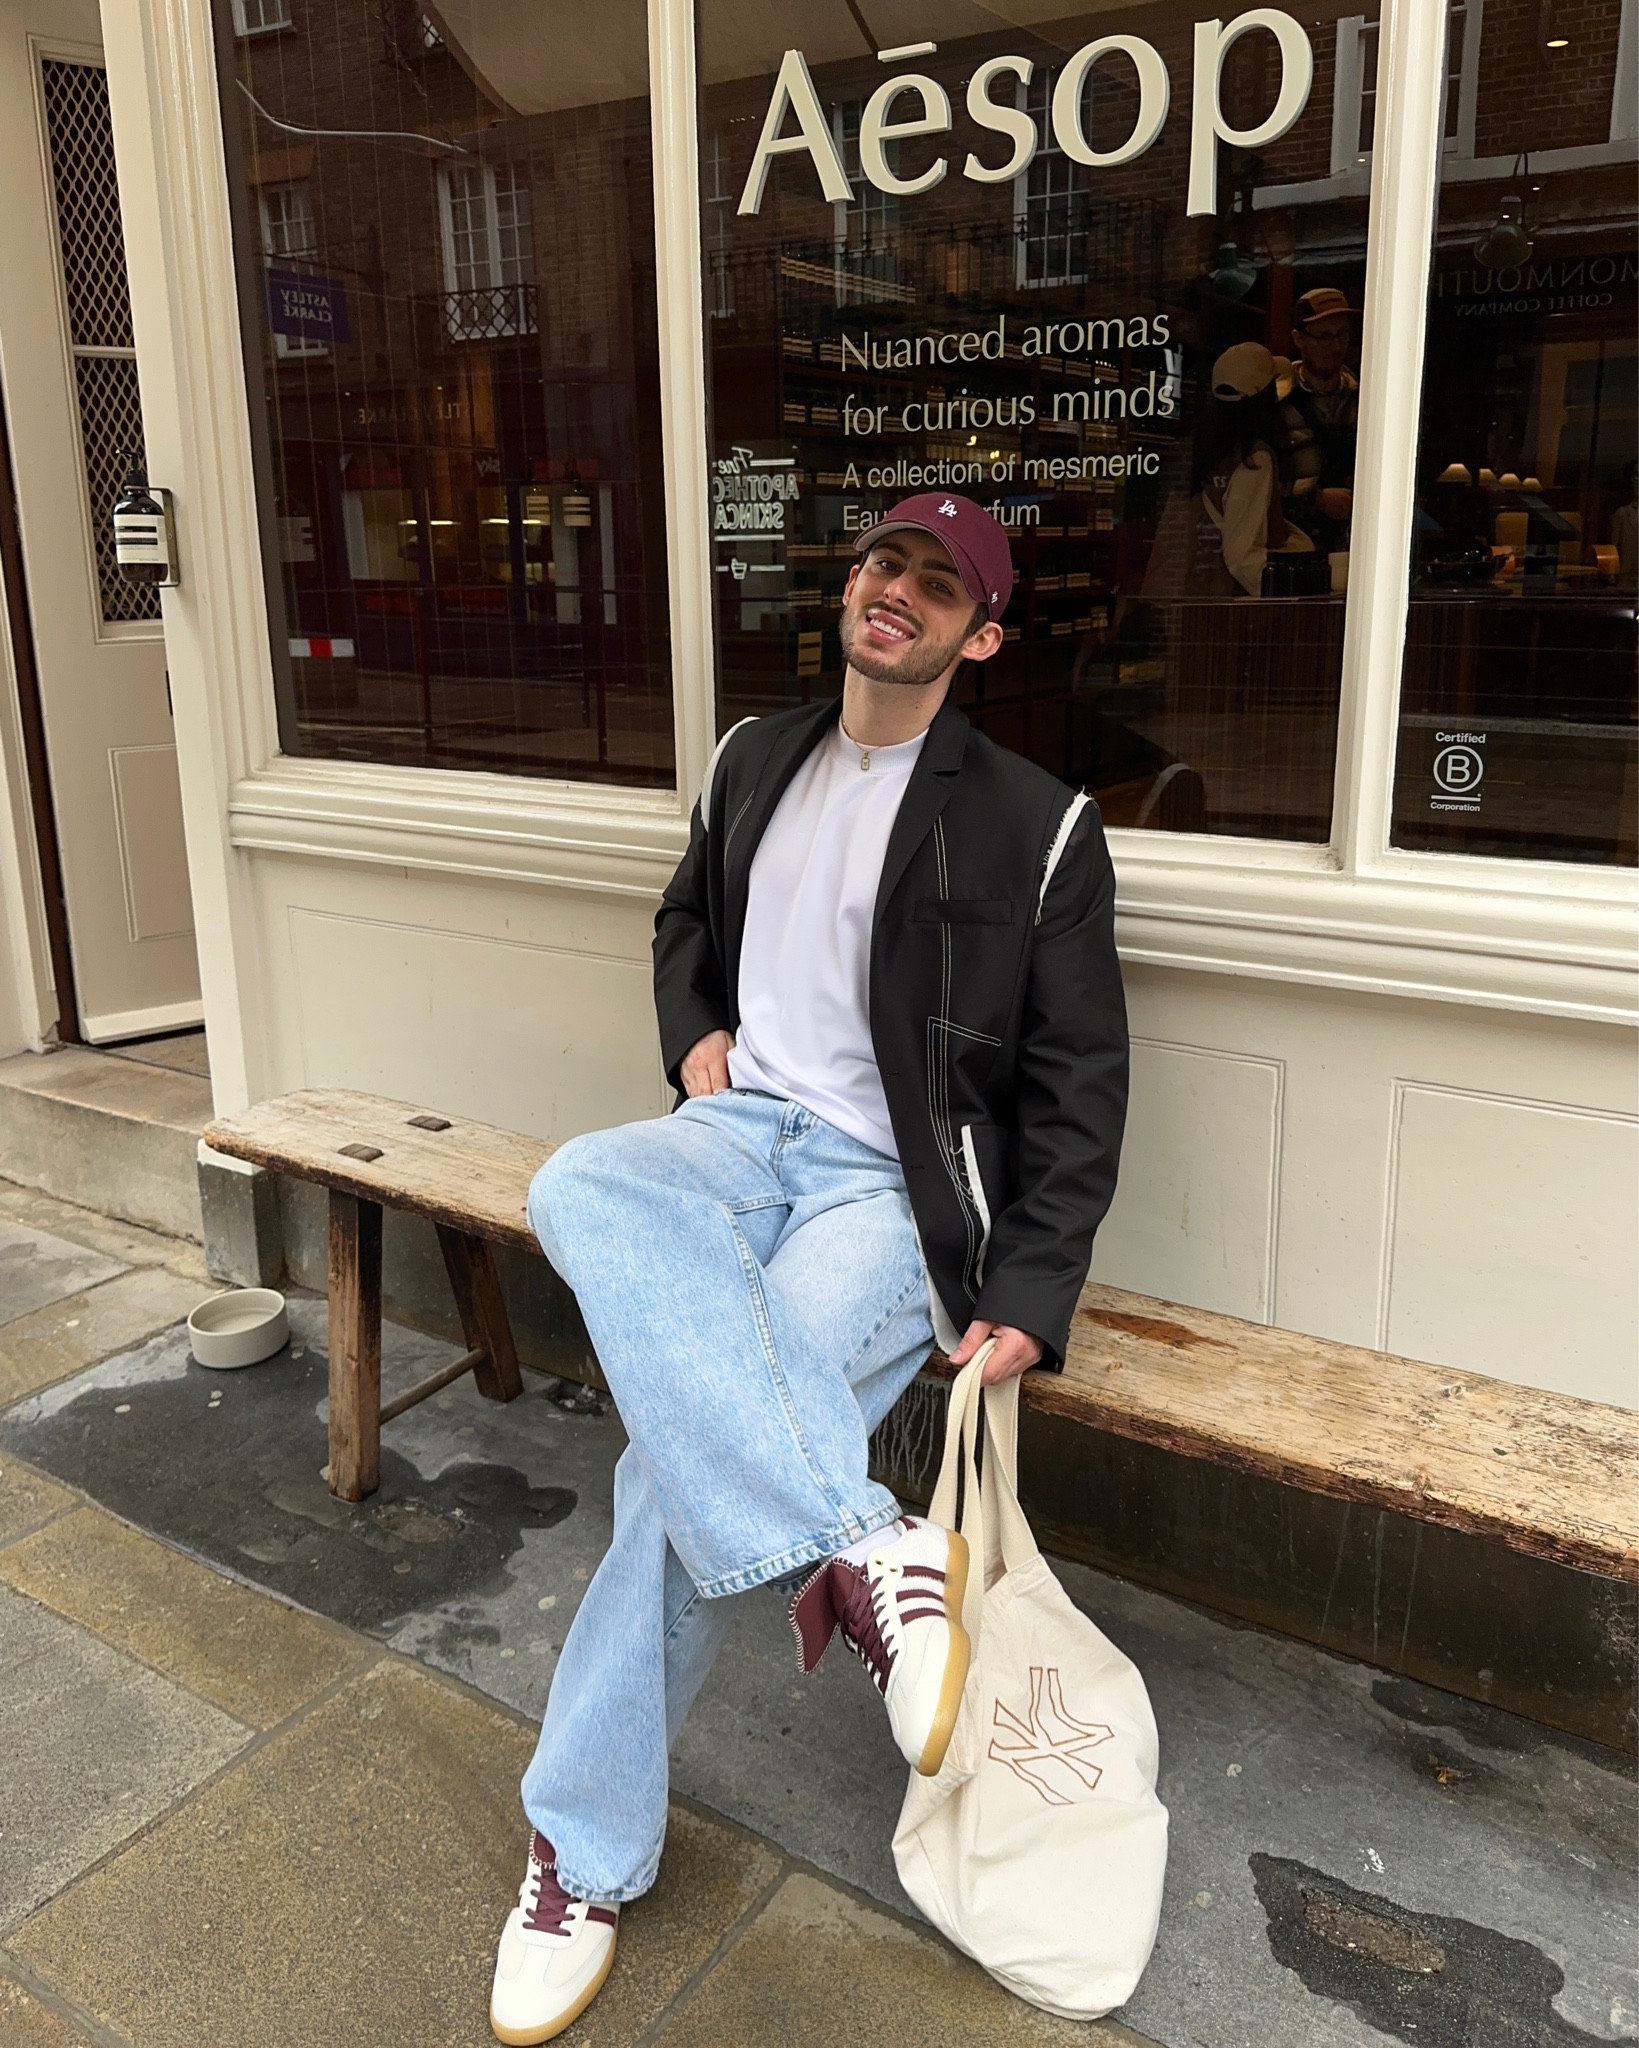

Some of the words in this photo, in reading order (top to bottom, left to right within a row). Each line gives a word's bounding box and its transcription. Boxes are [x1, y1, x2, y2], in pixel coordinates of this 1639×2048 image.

[736, 7, 1313, 218] Aēsop
[841, 314, 1006, 372] Nuanced
[1021, 314, 1171, 357] aromas
[841, 393, 889, 436] for
[901, 388, 1036, 432] curious
[1052, 370, 1176, 422] minds
[842, 462, 861, 489] A
[867, 458, 983, 488] collection
[991, 453, 1016, 482] of
[1024, 447, 1160, 481] mesmeric
[937, 499, 958, 518] LA
[1435, 731, 1487, 744] Certified
[1446, 754, 1471, 783] B
[1430, 801, 1481, 812] Corporation
